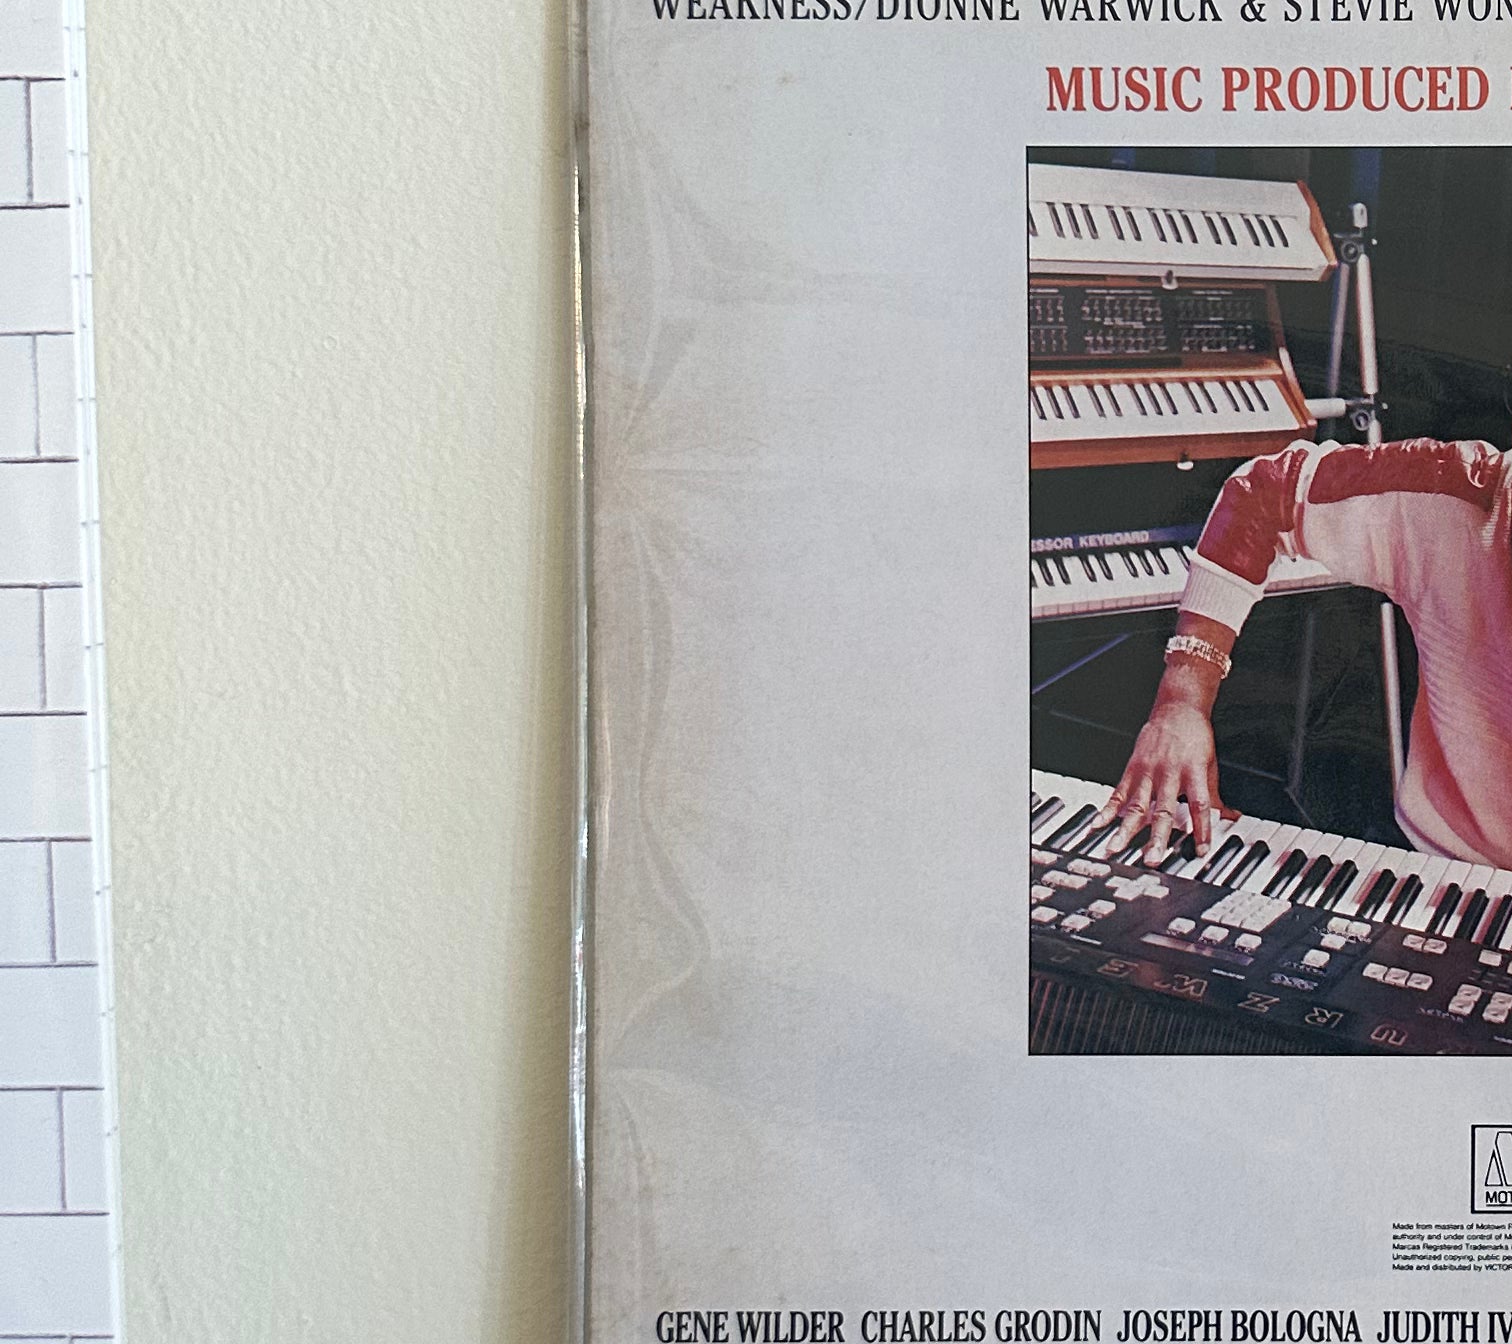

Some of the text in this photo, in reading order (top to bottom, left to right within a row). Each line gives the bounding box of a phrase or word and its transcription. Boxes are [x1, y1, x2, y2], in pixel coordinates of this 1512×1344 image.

[1046, 67, 1202, 112] MUSIC
[1222, 66, 1489, 112] PRODUCED
[1079, 530, 1149, 548] KEYBOARD
[656, 1311, 729, 1343] GENE
[736, 1311, 845, 1343] WILDER
[861, 1310, 986, 1343] CHARLES
[995, 1310, 1101, 1342] GRODIN
[1117, 1310, 1222, 1342] JOSEPH
[1231, 1310, 1362, 1342] BOLOGNA
[1377, 1311, 1479, 1343] JUDITH
